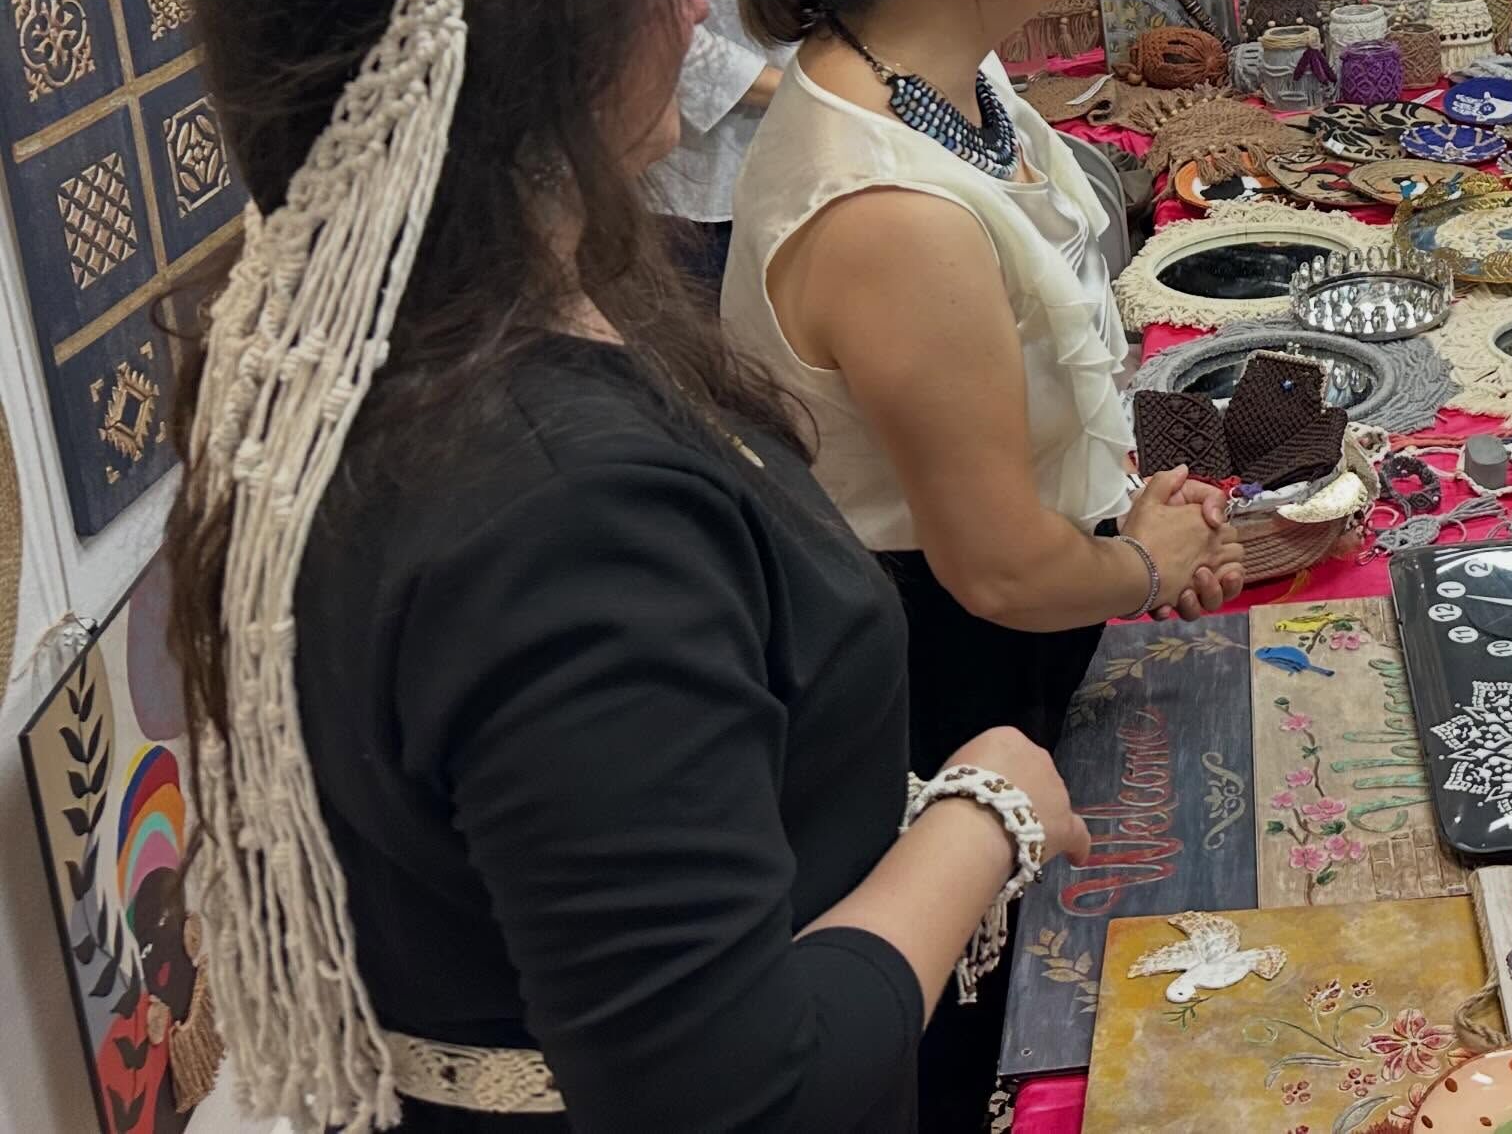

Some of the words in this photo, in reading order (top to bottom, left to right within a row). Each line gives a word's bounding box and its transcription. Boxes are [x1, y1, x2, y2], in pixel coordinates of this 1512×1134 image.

[1469, 562, 1489, 573] 2
[1441, 586, 1462, 594] 1
[1434, 604, 1456, 621] 12
[1454, 627, 1474, 641] 11
[1492, 641, 1511, 656] 10
[1058, 705, 1185, 916] Welcome
